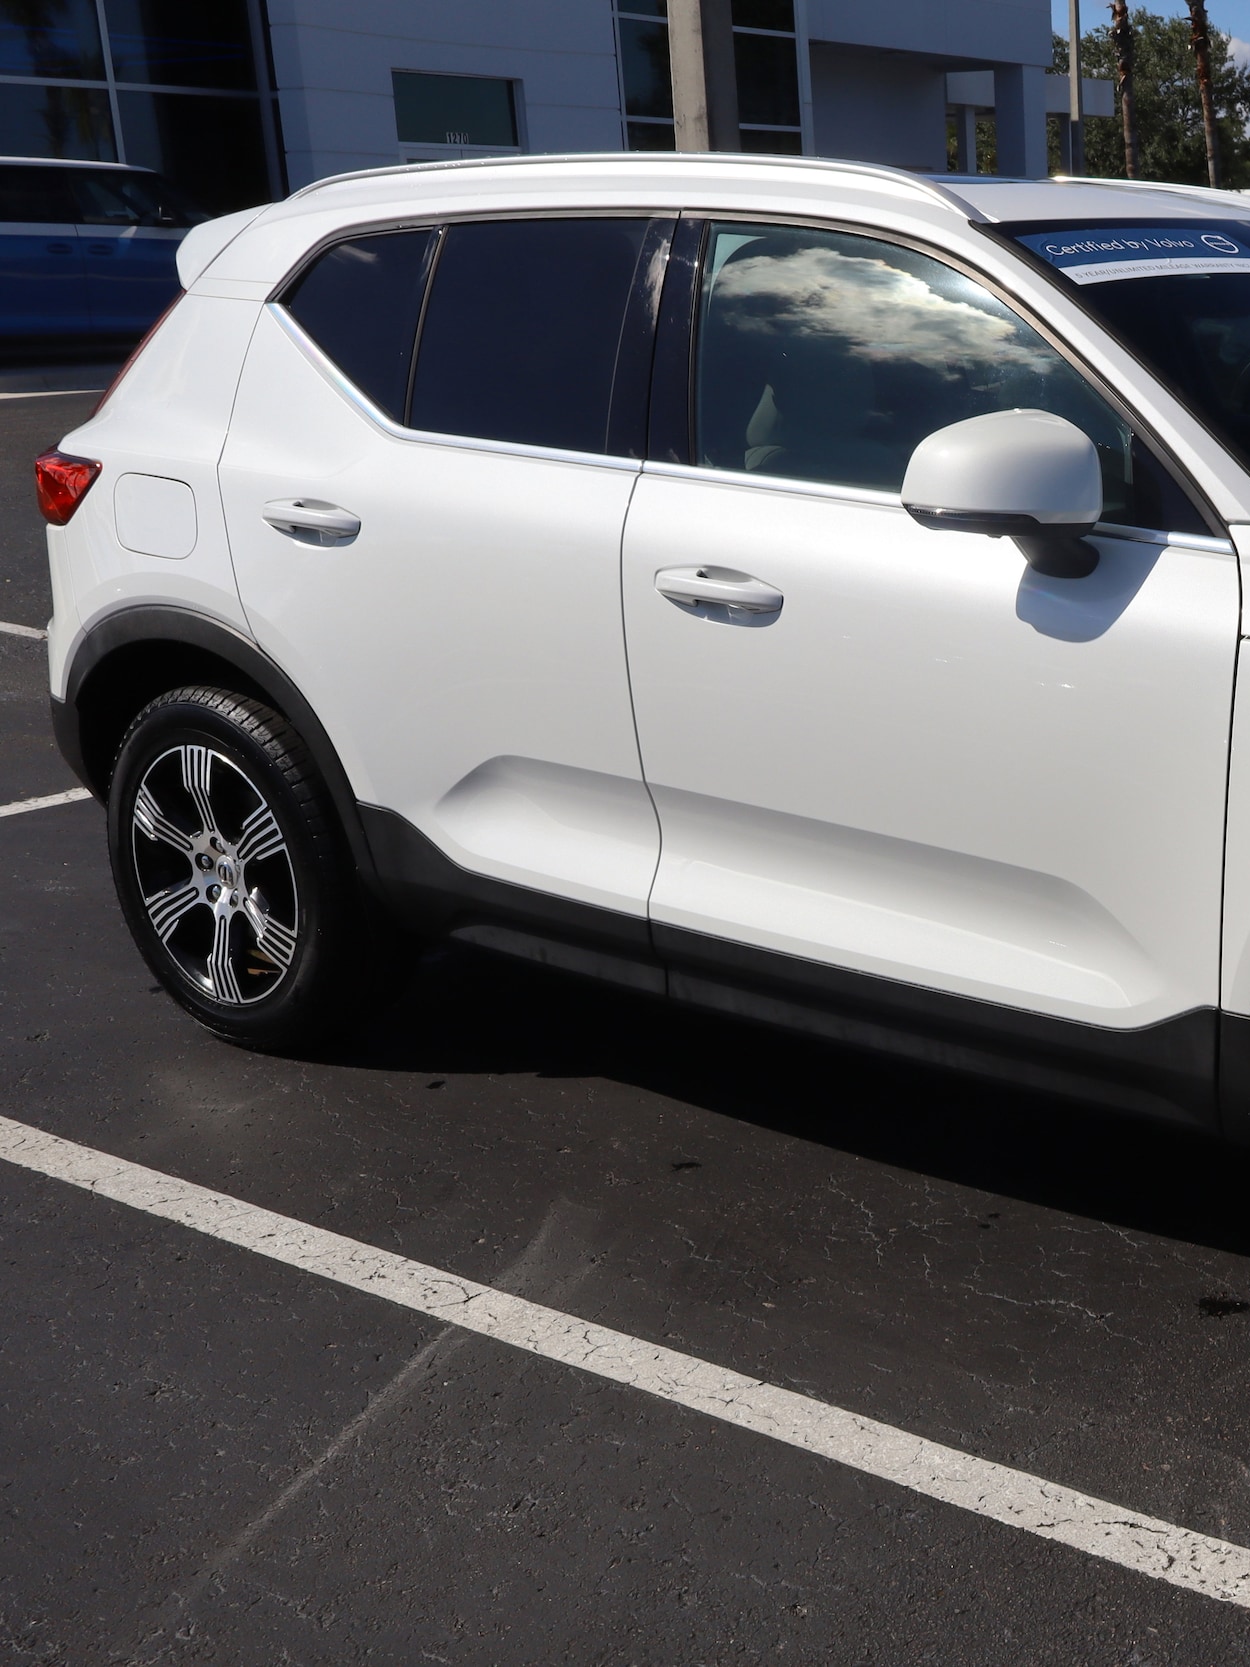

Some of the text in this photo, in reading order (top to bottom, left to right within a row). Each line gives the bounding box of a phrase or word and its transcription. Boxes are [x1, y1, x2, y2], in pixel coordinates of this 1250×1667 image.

[1045, 239, 1125, 256] Certified
[1121, 239, 1149, 251] by
[1144, 238, 1195, 249] Volvo
[1084, 265, 1156, 278] YEAR/UNLIMITED
